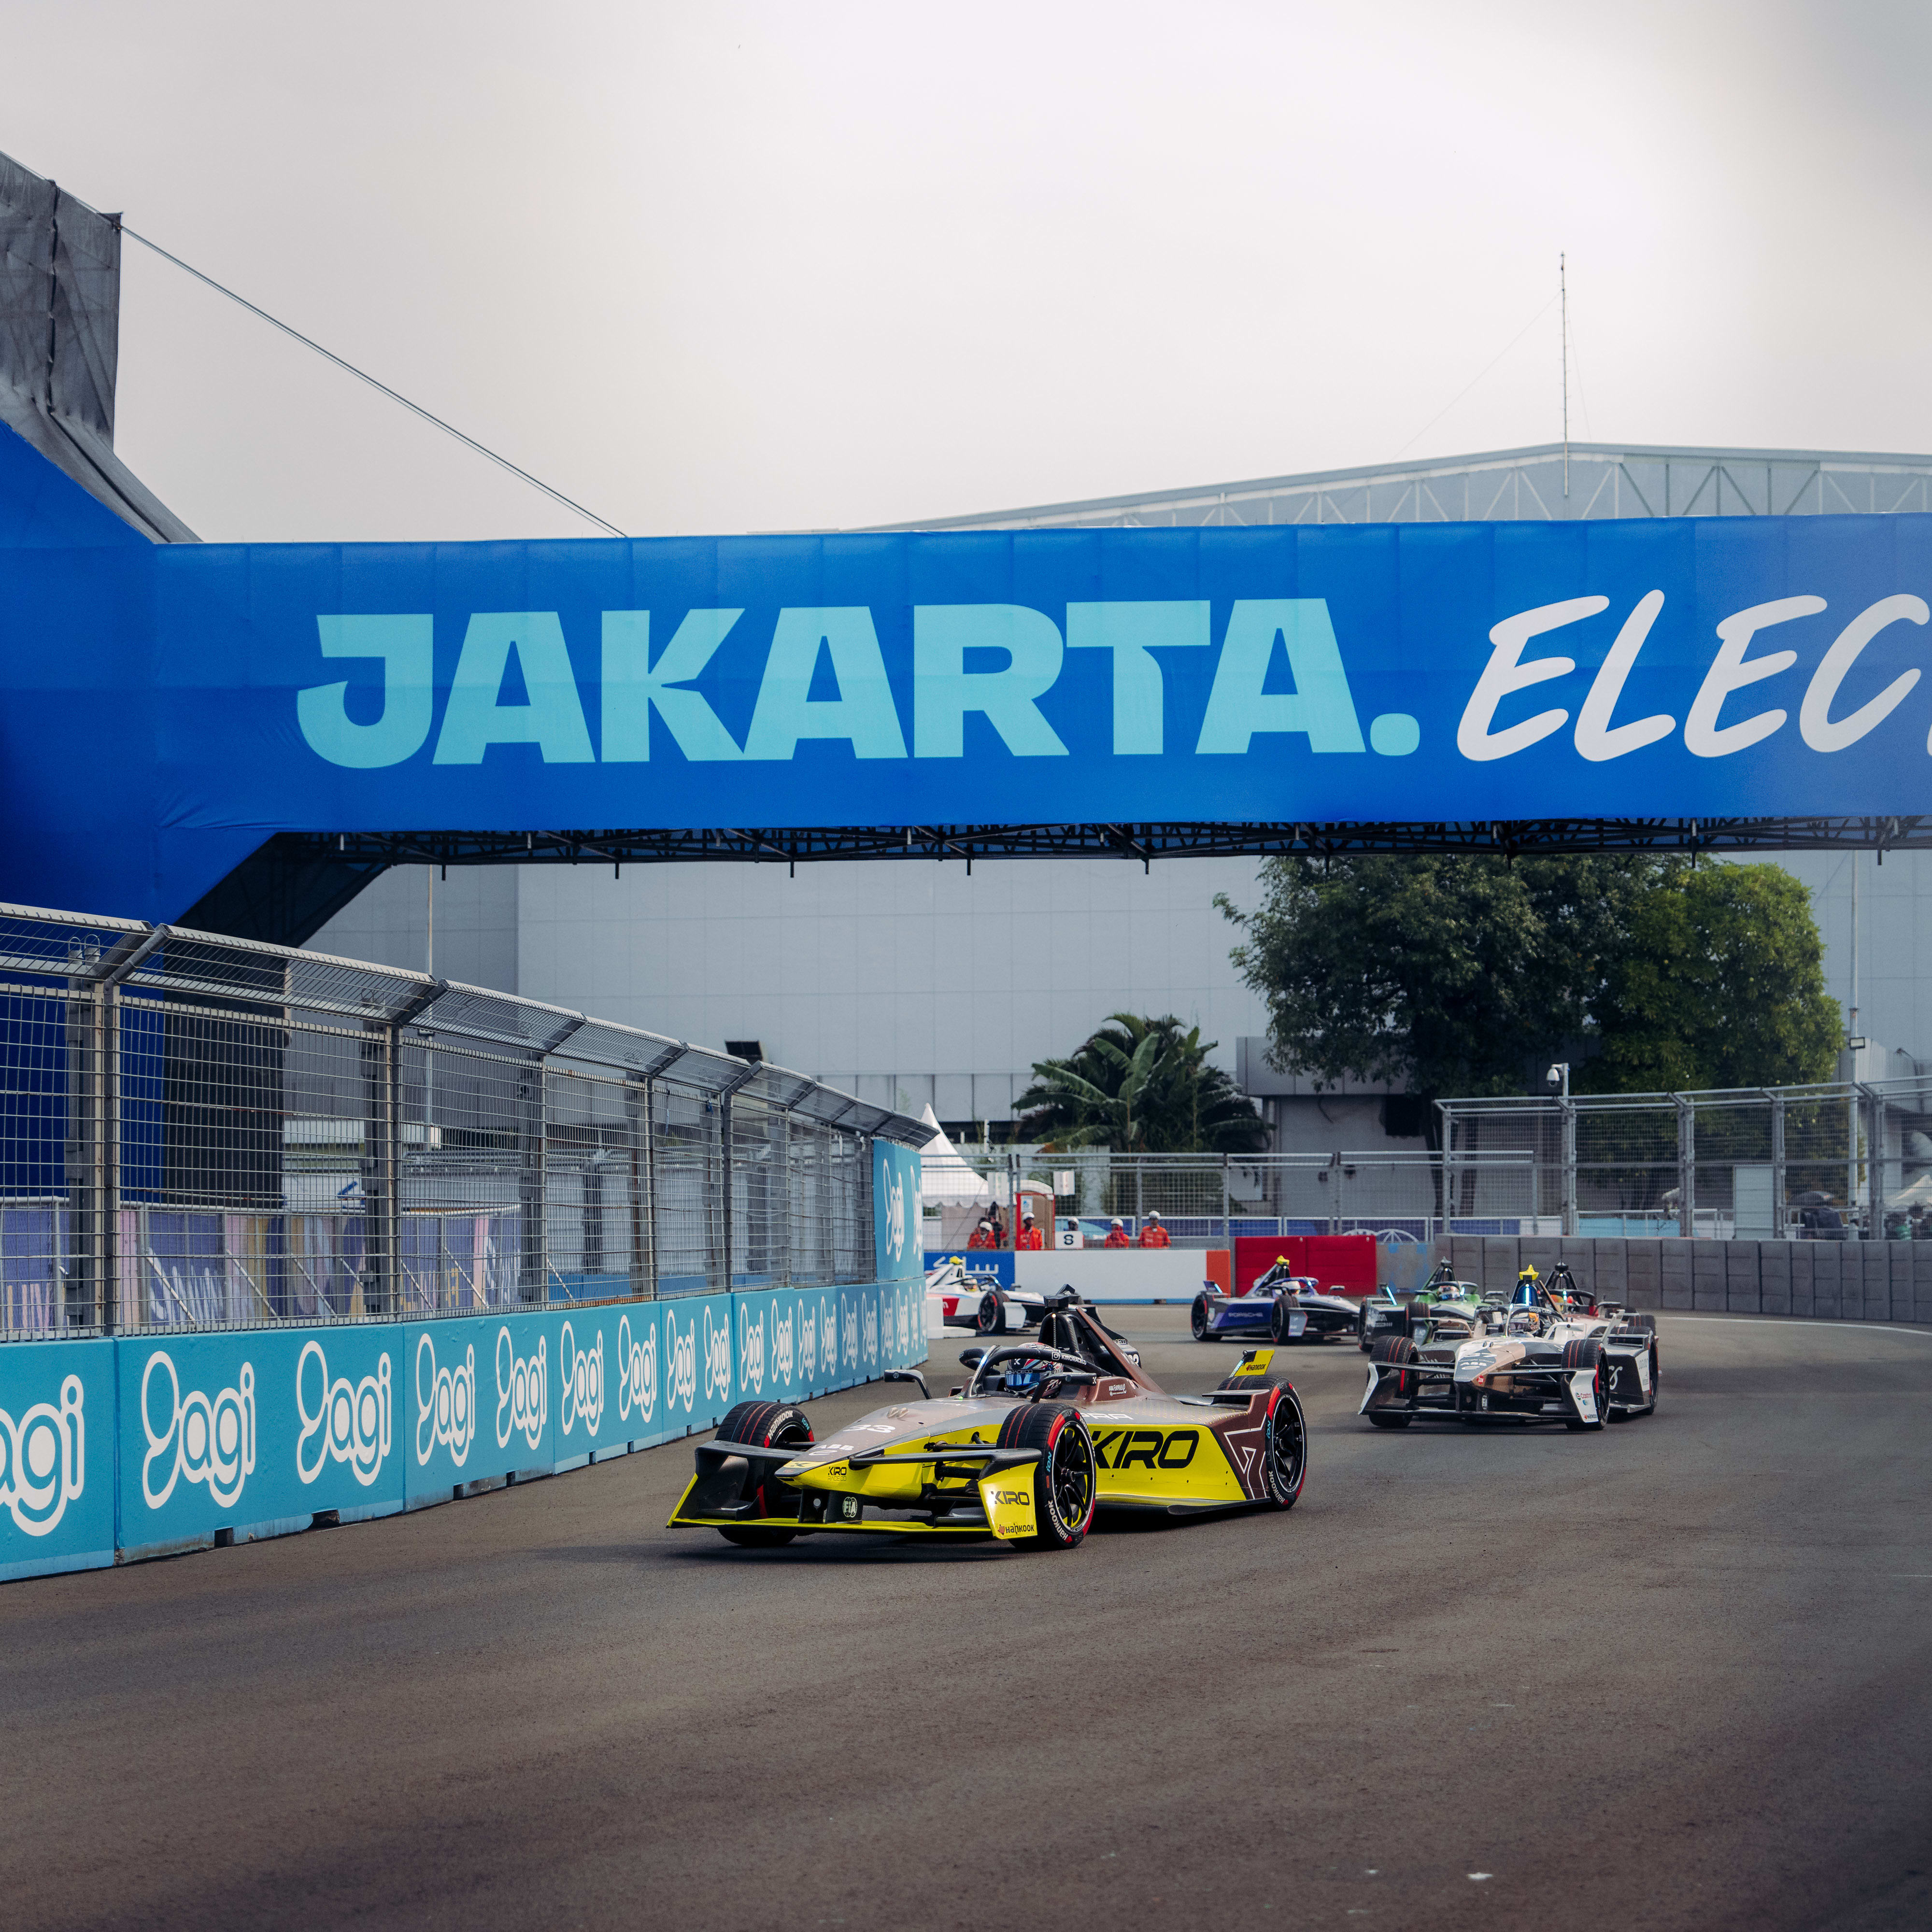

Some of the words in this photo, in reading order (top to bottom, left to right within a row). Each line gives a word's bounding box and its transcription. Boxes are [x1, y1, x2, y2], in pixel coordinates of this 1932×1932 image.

[297, 598, 1420, 769] JAKARTA.
[1457, 589, 1932, 762] ELEC
[843, 1424, 896, 1433] 33
[1091, 1430, 1200, 1469] KIRO
[828, 1466, 847, 1476] KIRO
[991, 1491, 1030, 1506] KIRO
